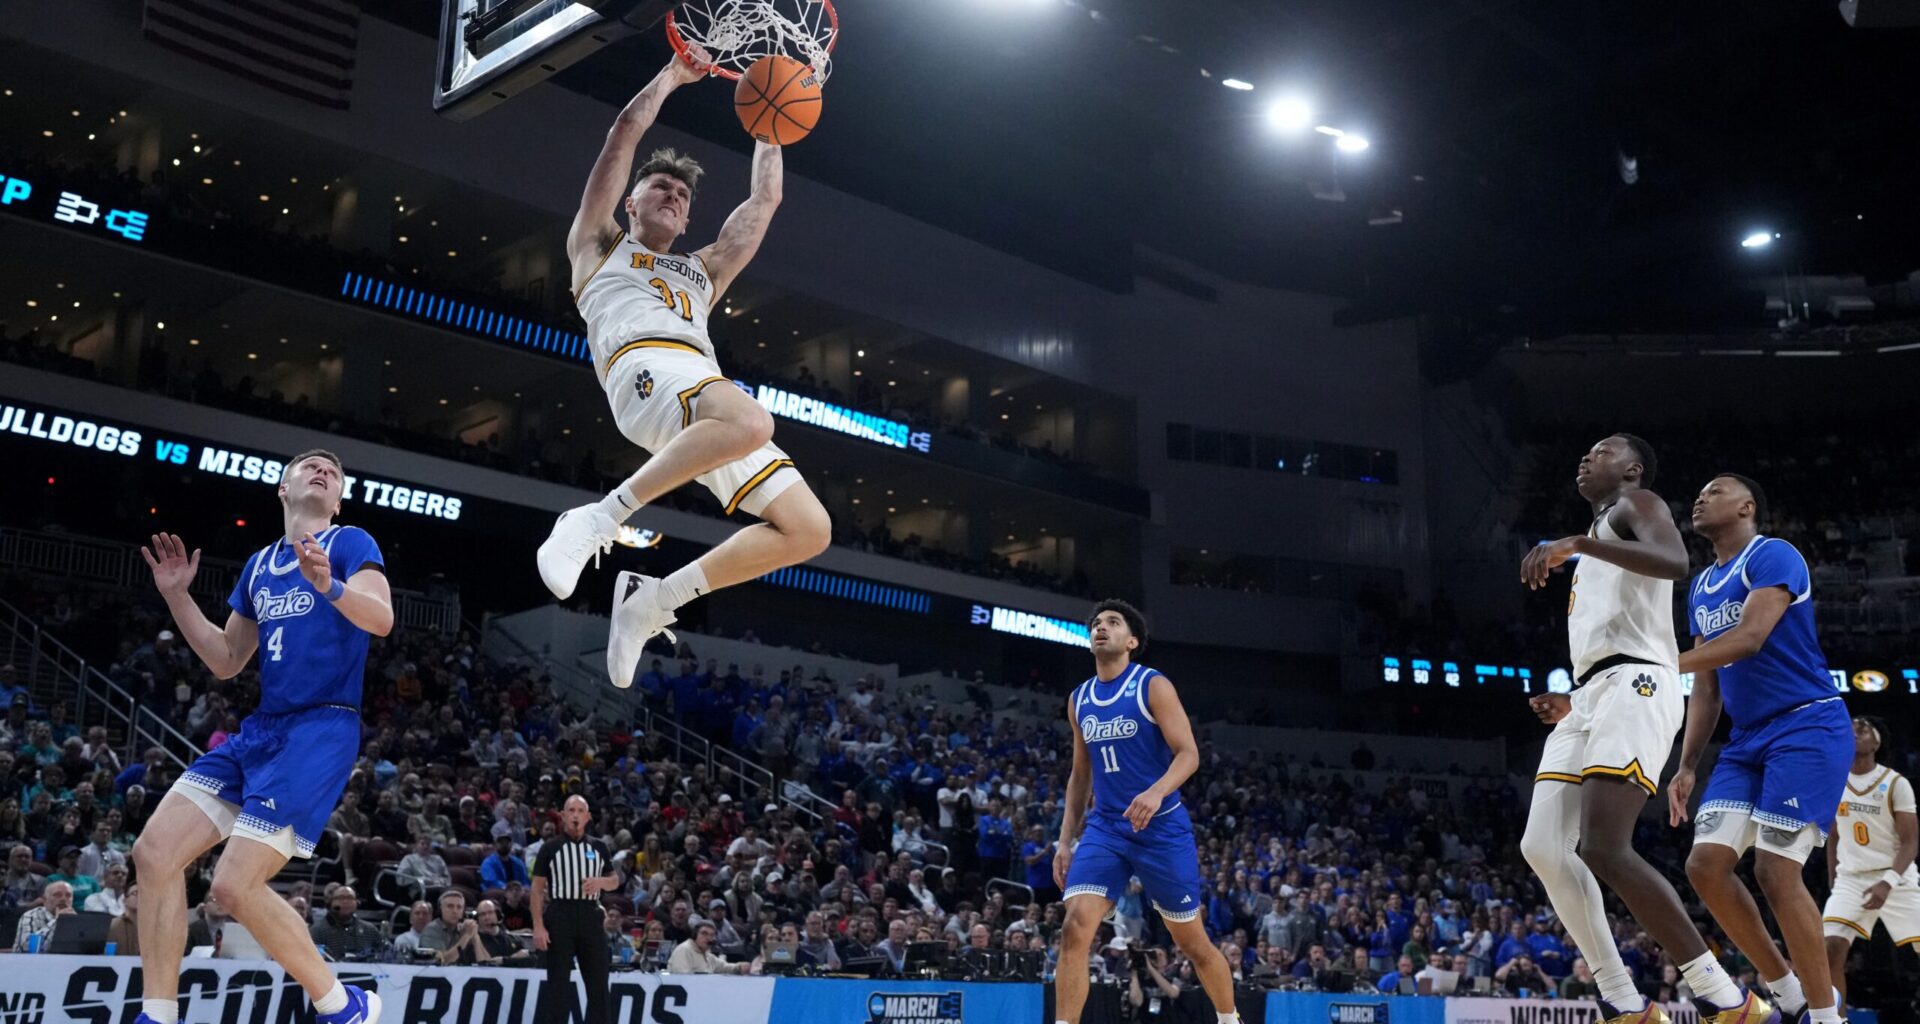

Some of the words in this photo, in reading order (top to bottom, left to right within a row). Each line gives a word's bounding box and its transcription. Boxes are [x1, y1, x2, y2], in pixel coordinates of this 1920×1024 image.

[631, 252, 707, 291] MISSOURI
[649, 277, 693, 322] 31
[156, 439, 189, 465] VS
[363, 479, 462, 521] TIGERS
[253, 586, 315, 625] Drake
[1695, 598, 1745, 637] Drake
[267, 626, 284, 662] 4
[1081, 714, 1138, 744] Drake
[1100, 745, 1120, 773] 11
[1853, 821, 1870, 846] 0
[884, 997, 939, 1018] MARCH
[1339, 1006, 1374, 1023] MARCH
